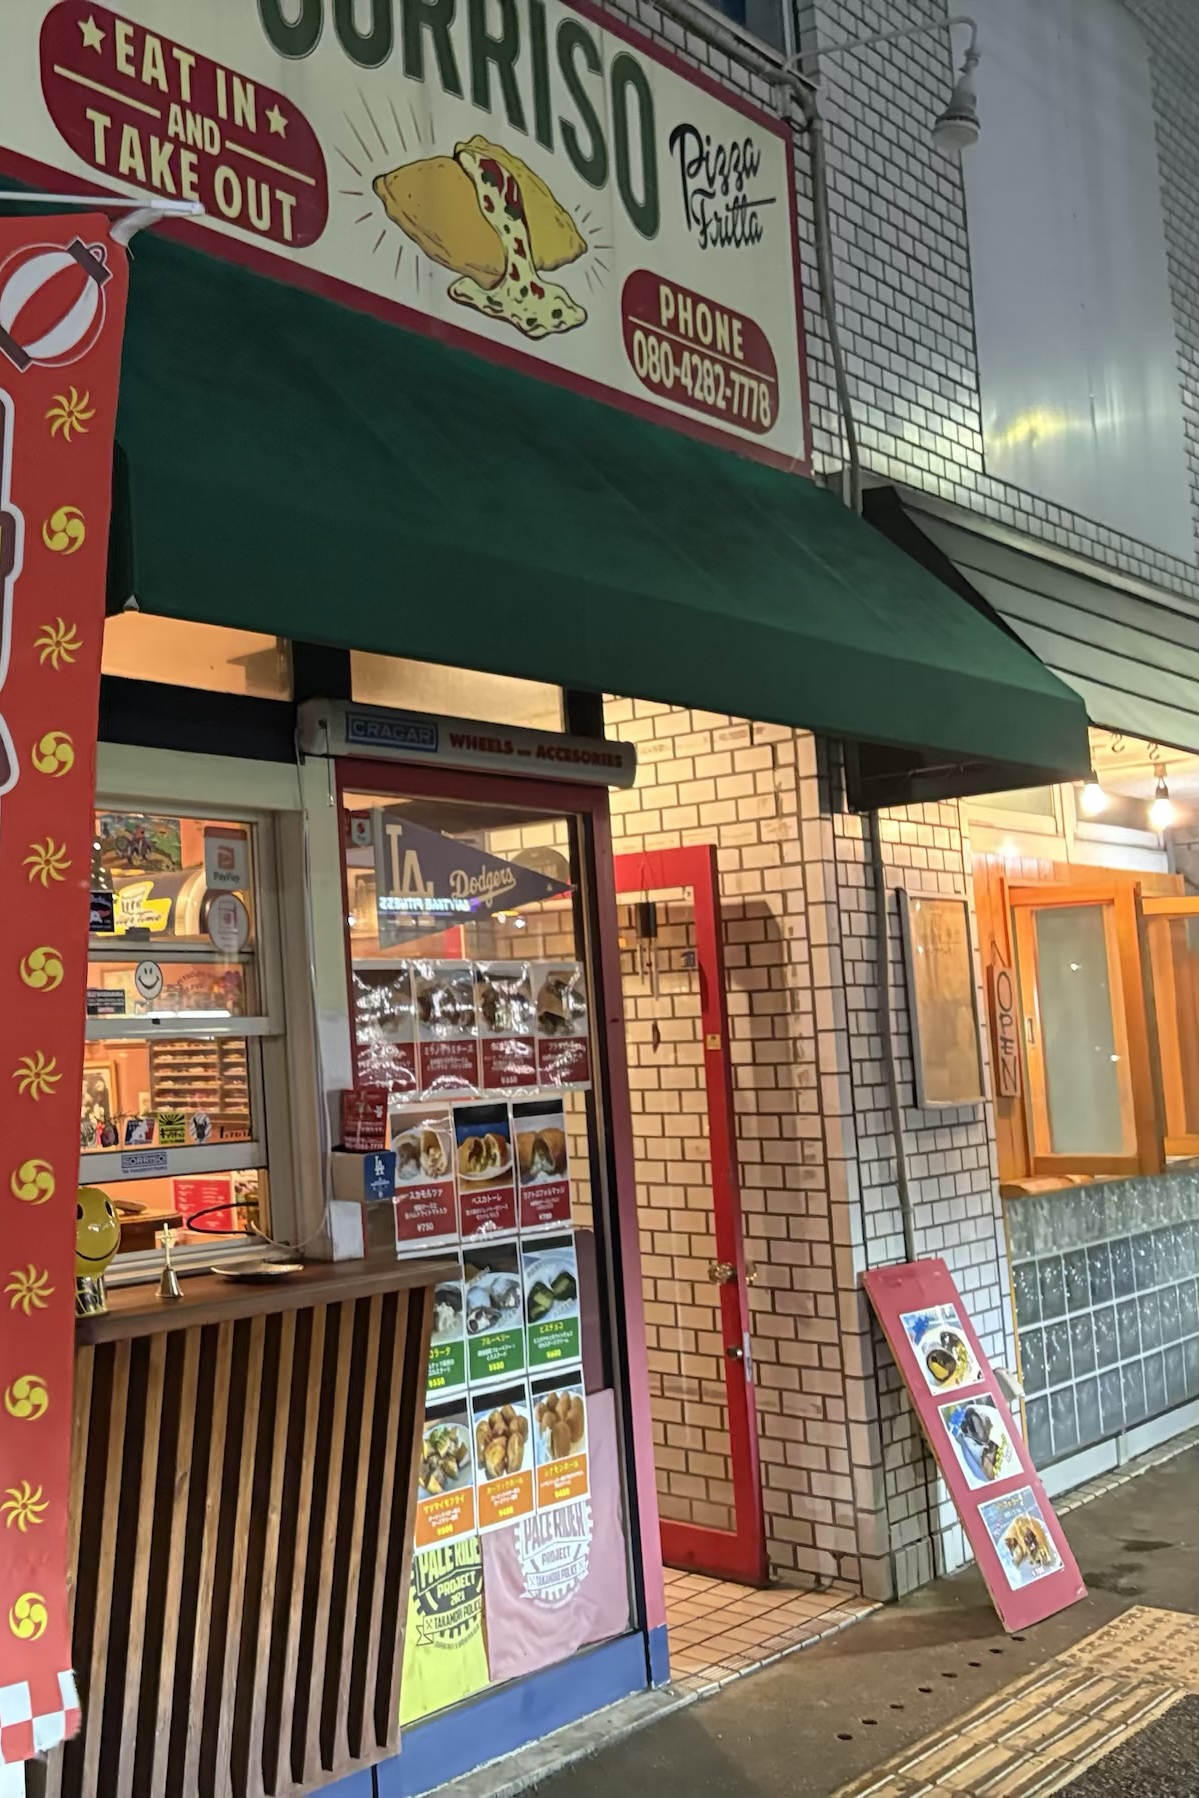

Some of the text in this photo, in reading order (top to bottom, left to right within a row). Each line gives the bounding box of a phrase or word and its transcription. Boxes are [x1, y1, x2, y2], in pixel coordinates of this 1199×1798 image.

[114, 18, 257, 134] EAT IN
[167, 102, 221, 157] AND
[256, 0, 660, 240] RRISO
[85, 106, 297, 241] TAKE OUT
[669, 123, 761, 232] Pizza
[690, 188, 777, 251] Fritta
[659, 284, 745, 361] PHONE
[632, 329, 773, 428] 080-4282-7778
[449, 732, 513, 756] WHEELS
[213, 871, 241, 883] PayPay
[385, 824, 434, 927] LA
[450, 864, 516, 908] Dodgers
[996, 971, 1018, 1093] OPEN
[374, 1155, 386, 1176] LA
[454, 1535, 480, 1568] RIDE
[524, 1509, 554, 1556] PALE
[541, 1545, 571, 1565] PROJECT
[437, 1571, 476, 1599] PROJECT
